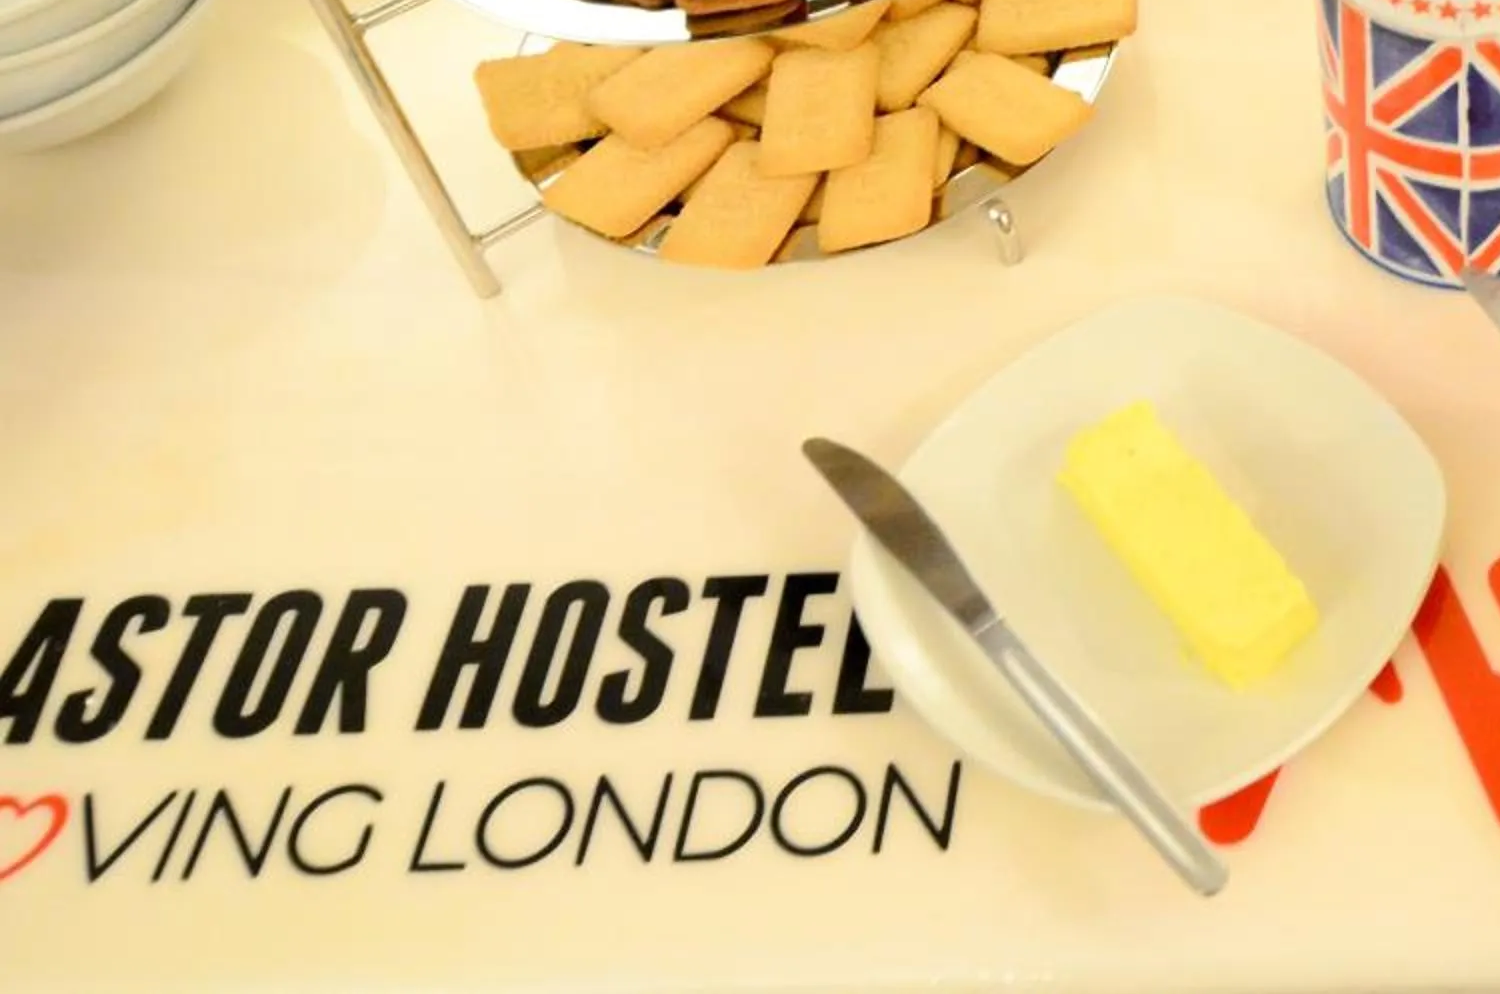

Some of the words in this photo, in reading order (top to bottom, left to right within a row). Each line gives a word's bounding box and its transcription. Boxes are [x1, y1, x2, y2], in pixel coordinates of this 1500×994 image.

[0, 587, 409, 746] ASTOR
[414, 570, 897, 733] HOSTEL
[408, 760, 963, 874] LONDON
